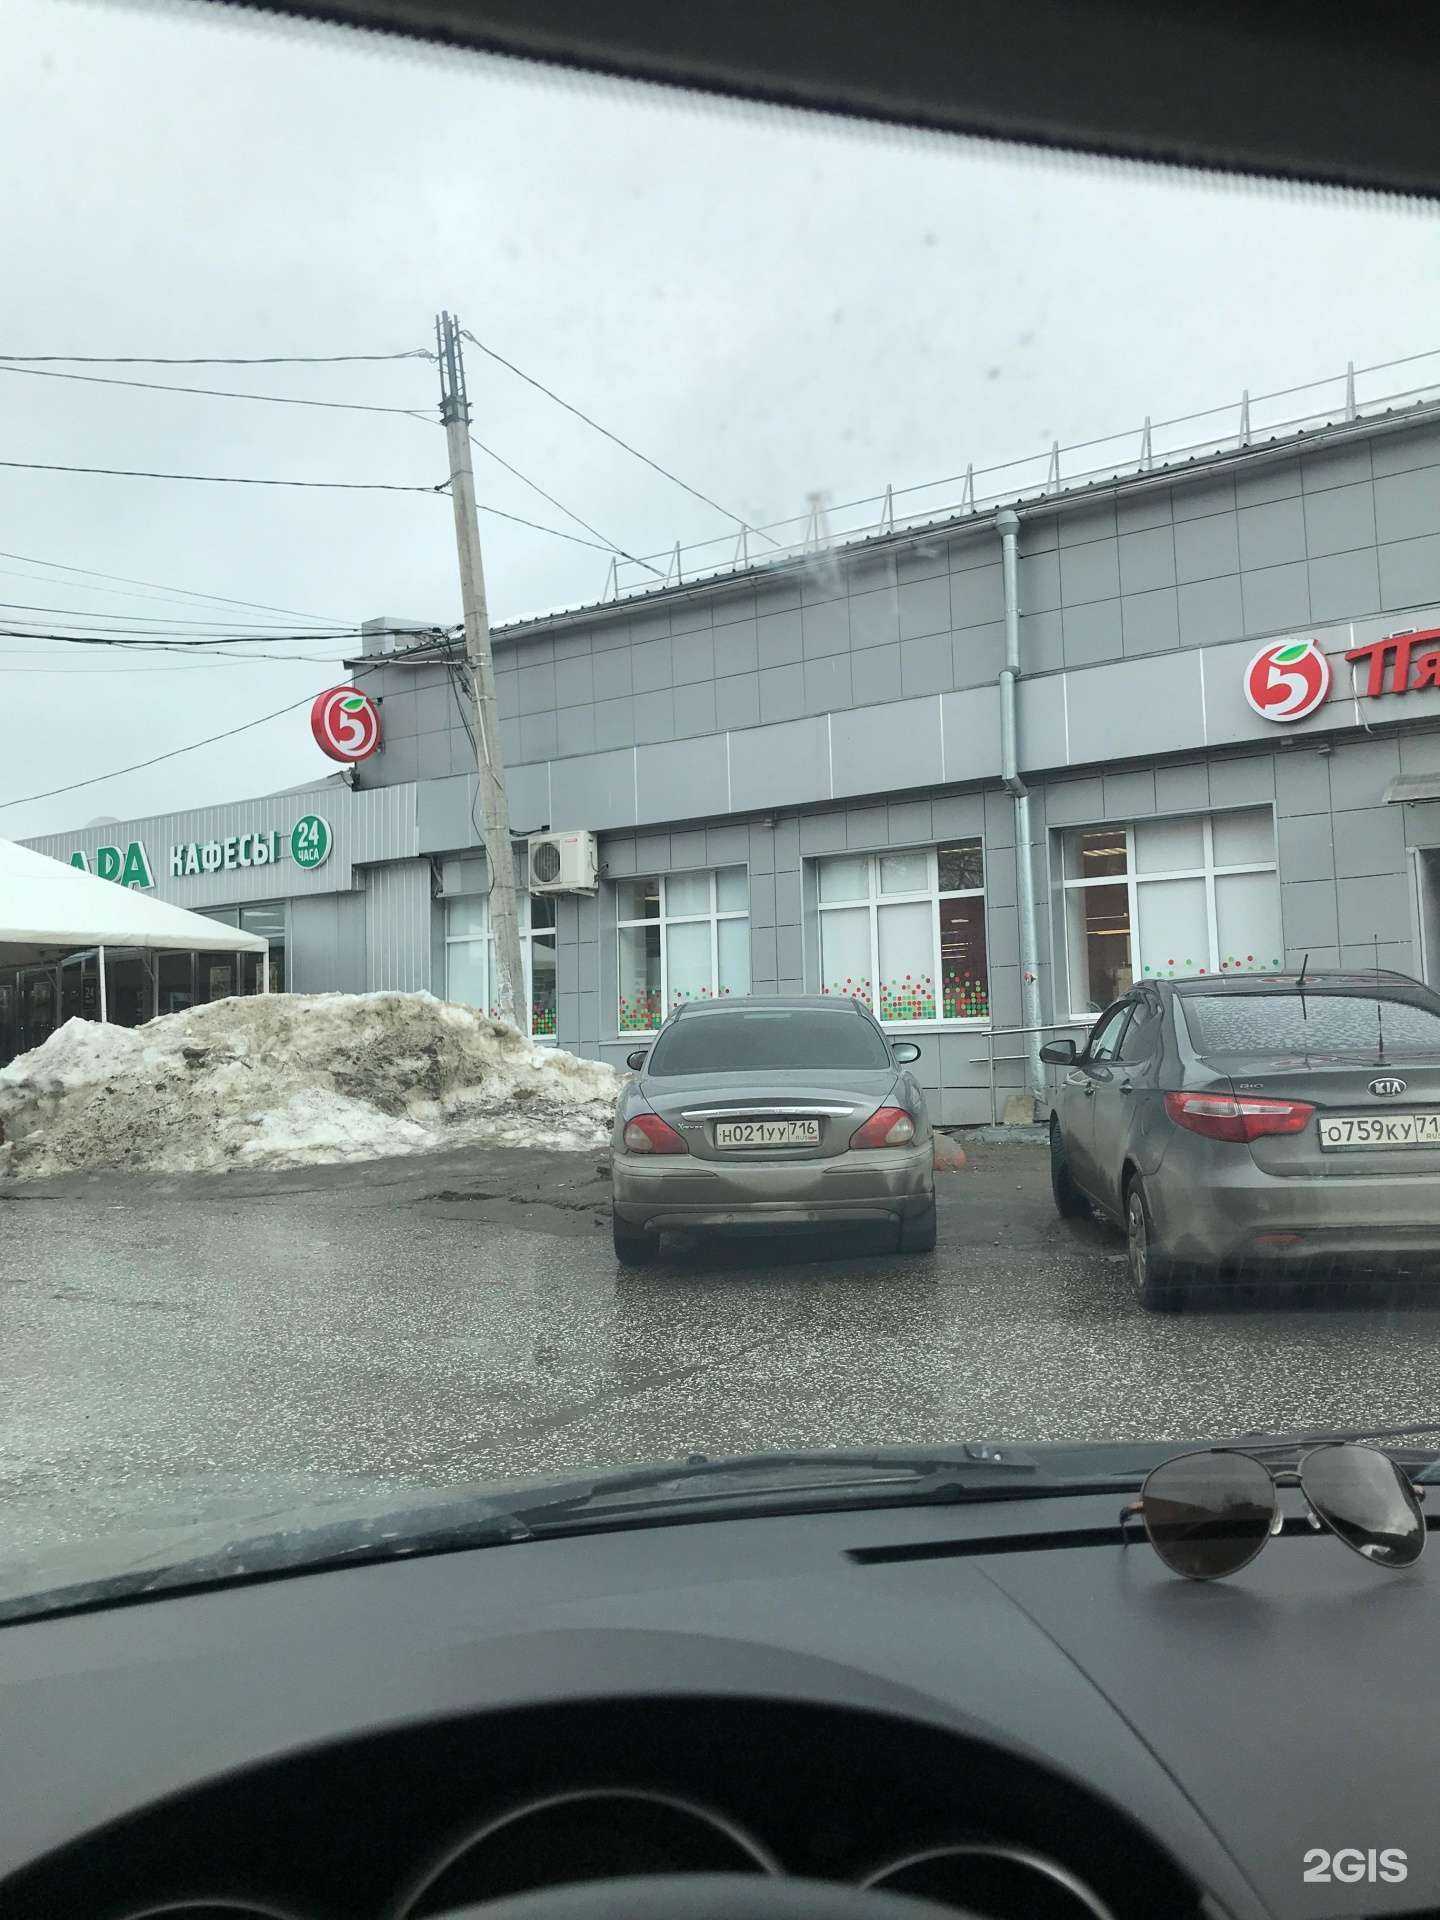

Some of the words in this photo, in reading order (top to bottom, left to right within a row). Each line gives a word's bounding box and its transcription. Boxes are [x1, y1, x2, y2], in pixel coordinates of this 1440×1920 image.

[298, 820, 320, 848] 24
[169, 830, 280, 877] КАФЕСЫ
[298, 847, 320, 862] ЧАСА
[1374, 1081, 1402, 1095] KIA
[789, 1121, 815, 1135] 716
